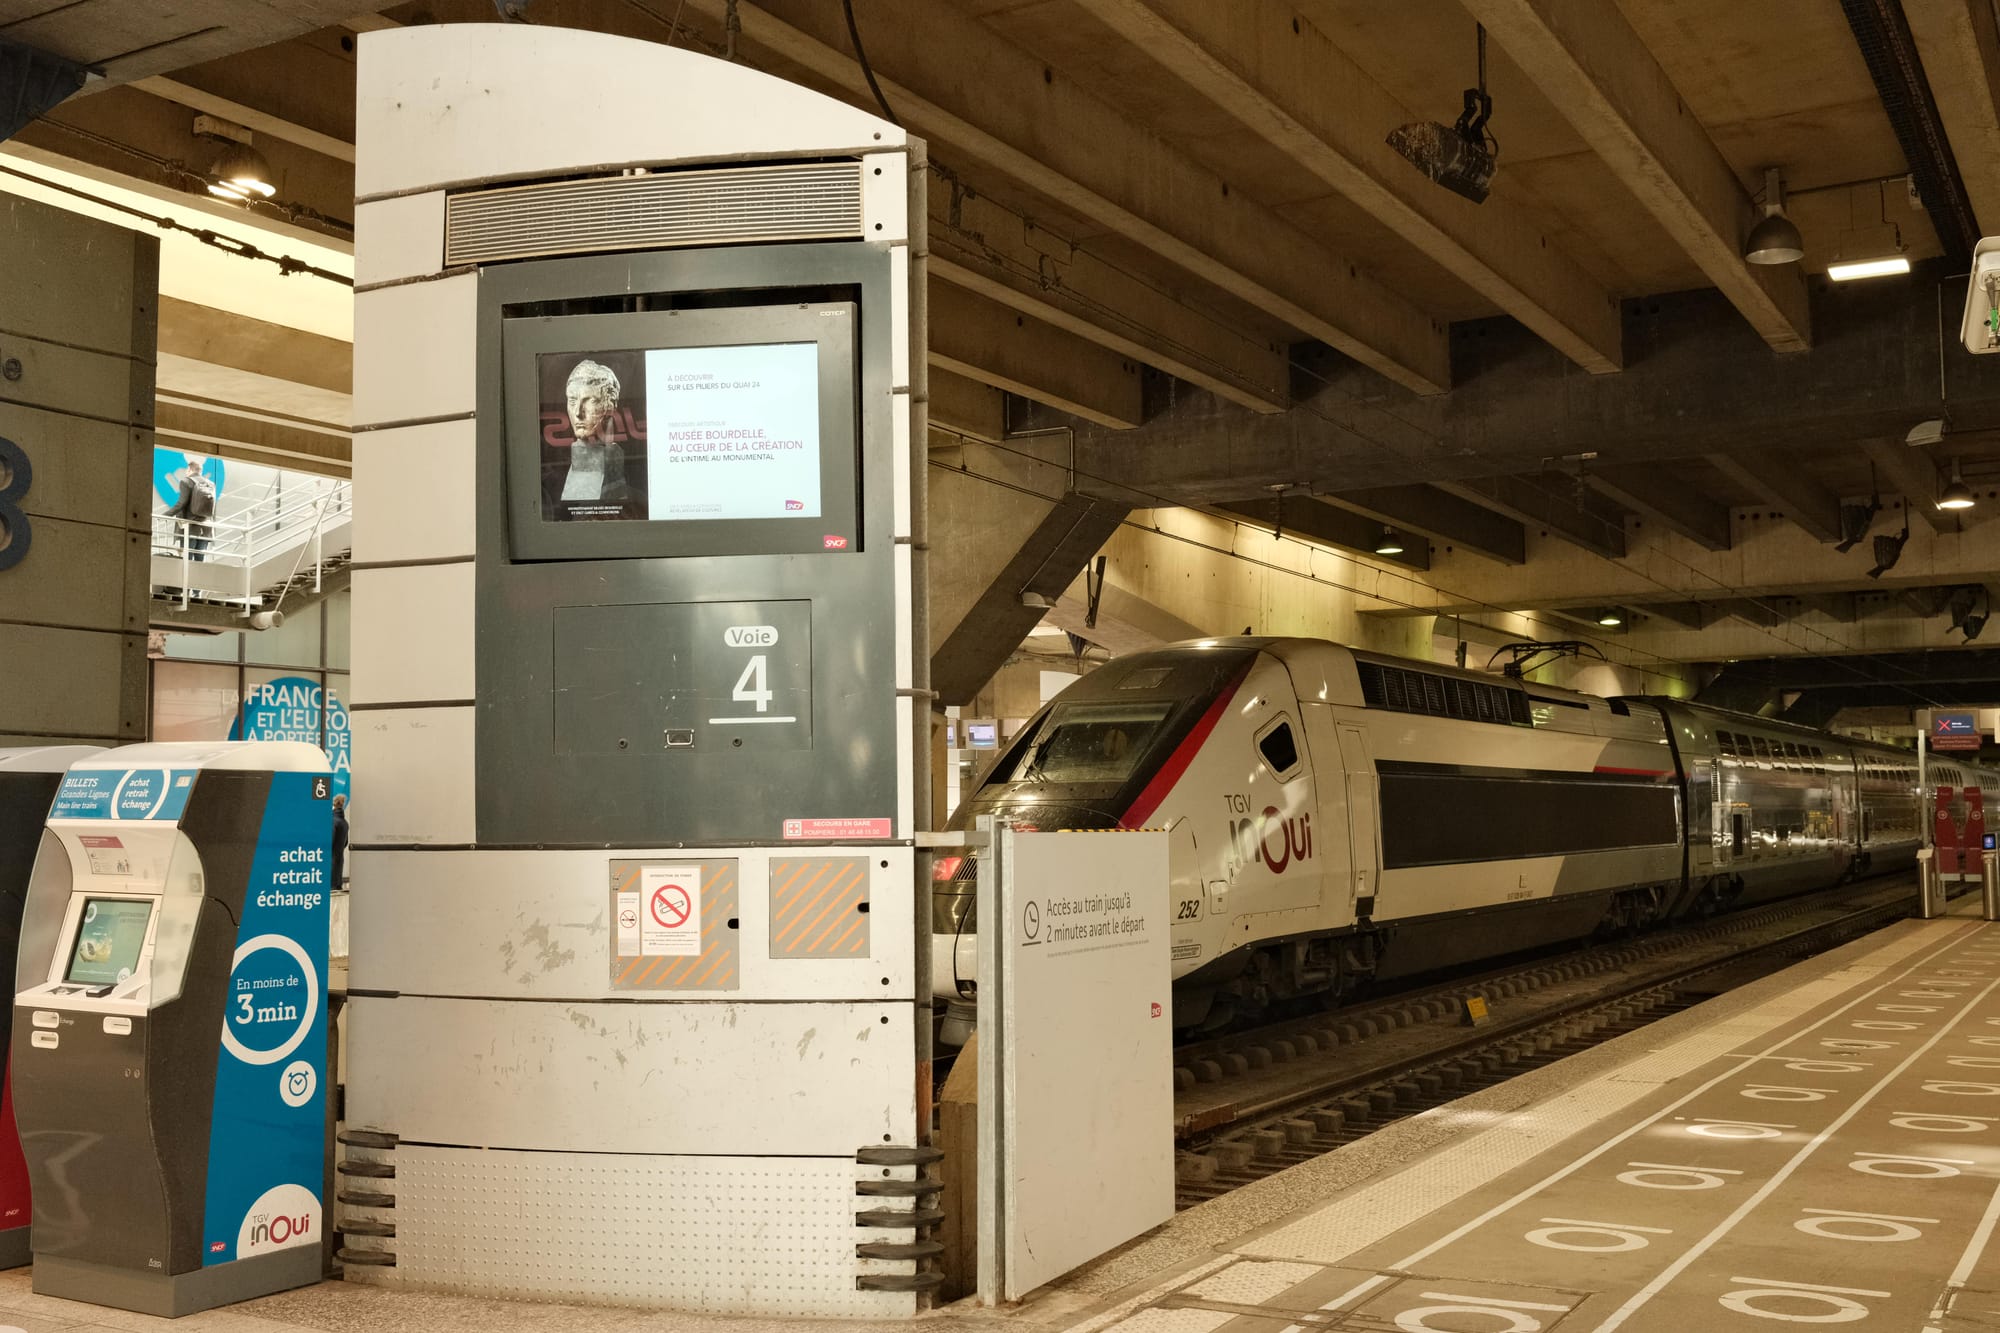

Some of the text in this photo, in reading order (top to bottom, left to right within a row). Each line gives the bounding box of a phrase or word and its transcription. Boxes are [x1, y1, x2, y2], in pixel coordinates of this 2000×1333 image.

[682, 383, 694, 391] LES
[695, 382, 719, 390] PILIERS
[732, 381, 751, 389] QUAI
[668, 429, 767, 441] MUSÉE BOURDELLE,
[668, 438, 803, 453] AU CŒUR DE LA CRÉATION
[711, 454, 721, 462] AU
[722, 453, 775, 462] MONUMENTAL
[824, 539, 848, 547] SNCF
[731, 629, 770, 644] Voie
[733, 655, 773, 712] 4
[247, 683, 338, 709] FRANCE
[257, 712, 277, 727] ET
[328, 732, 349, 748] DE
[65, 778, 99, 788] BILLETS
[129, 778, 150, 787] achat
[61, 790, 110, 800] Grandes Lignes
[125, 789, 149, 798] retrait
[56, 801, 71, 809] Main
[71, 801, 81, 809] line
[121, 799, 151, 811] échange
[1223, 794, 1251, 814] TGV
[280, 846, 323, 863] achat
[272, 867, 323, 885] retrait
[257, 890, 322, 910] échange
[1047, 892, 1131, 917] Accès au train jusqu'à
[1178, 899, 1200, 919] 252
[1046, 915, 1145, 943] 2 minutes avant le départ
[236, 974, 299, 990] En moins de
[235, 993, 297, 1025] 3 min
[252, 1213, 269, 1224] TGV
